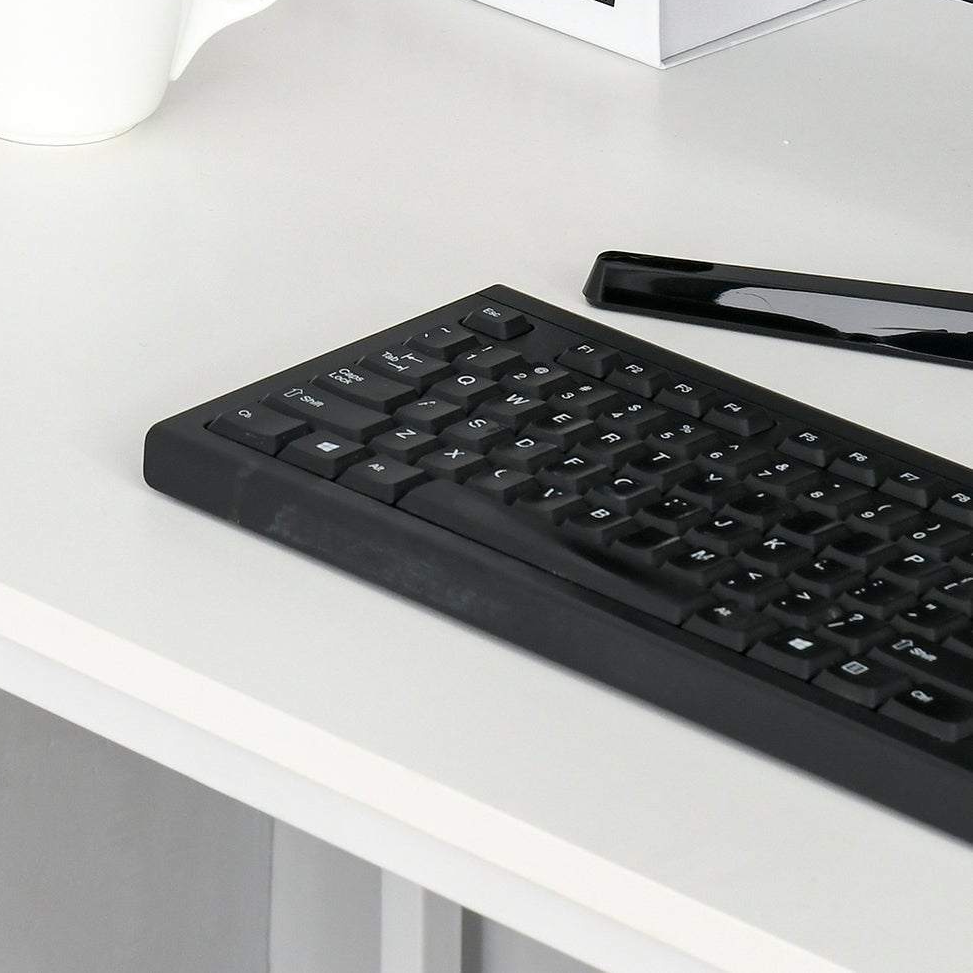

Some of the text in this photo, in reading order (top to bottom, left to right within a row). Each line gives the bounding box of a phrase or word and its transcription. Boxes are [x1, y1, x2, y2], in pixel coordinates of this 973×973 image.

[577, 344, 595, 354] F1
[625, 364, 644, 374] F2
[457, 375, 476, 386] Q
[674, 383, 693, 393] F3
[506, 393, 530, 405] W
[723, 402, 742, 412] F4
[552, 413, 572, 423] E
[468, 419, 487, 428] S
[600, 432, 621, 443] R
[798, 432, 818, 442] F5
[515, 438, 535, 448] D
[444, 448, 465, 459] X
[652, 452, 671, 461] T
[848, 452, 868, 462] F6
[563, 457, 584, 465] F
[899, 472, 920, 482] F7
[951, 492, 971, 503] F8
[590, 508, 611, 519] B
[763, 538, 786, 550] K
[904, 554, 925, 563] P
